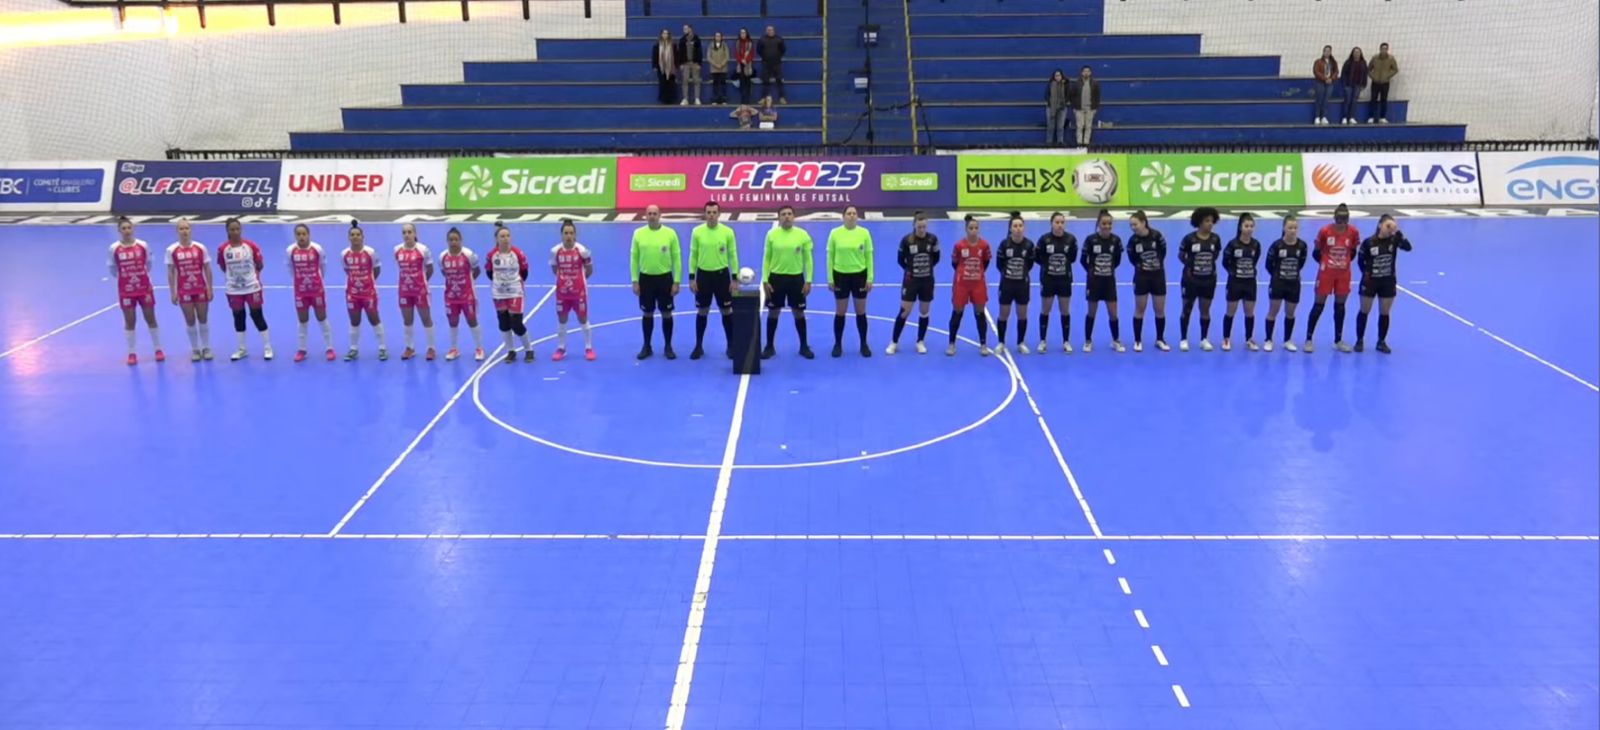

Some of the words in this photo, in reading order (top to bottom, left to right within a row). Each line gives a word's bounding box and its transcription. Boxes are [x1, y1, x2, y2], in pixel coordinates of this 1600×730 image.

[288, 174, 384, 192] UNIDEP
[498, 167, 608, 195] Sicredi
[647, 177, 682, 187] Sicredi
[702, 161, 865, 190] LFF2025
[898, 176, 933, 187] Sicredi
[966, 171, 1036, 190] MUNICH
[1182, 165, 1294, 192] Sicredi
[1352, 164, 1476, 184] ATLAS
[0, 178, 24, 195] BC
[711, 193, 734, 202] LIGA
[740, 193, 789, 202] FEMININA
[795, 193, 807, 202] DE
[812, 193, 851, 202] FUTSAL
